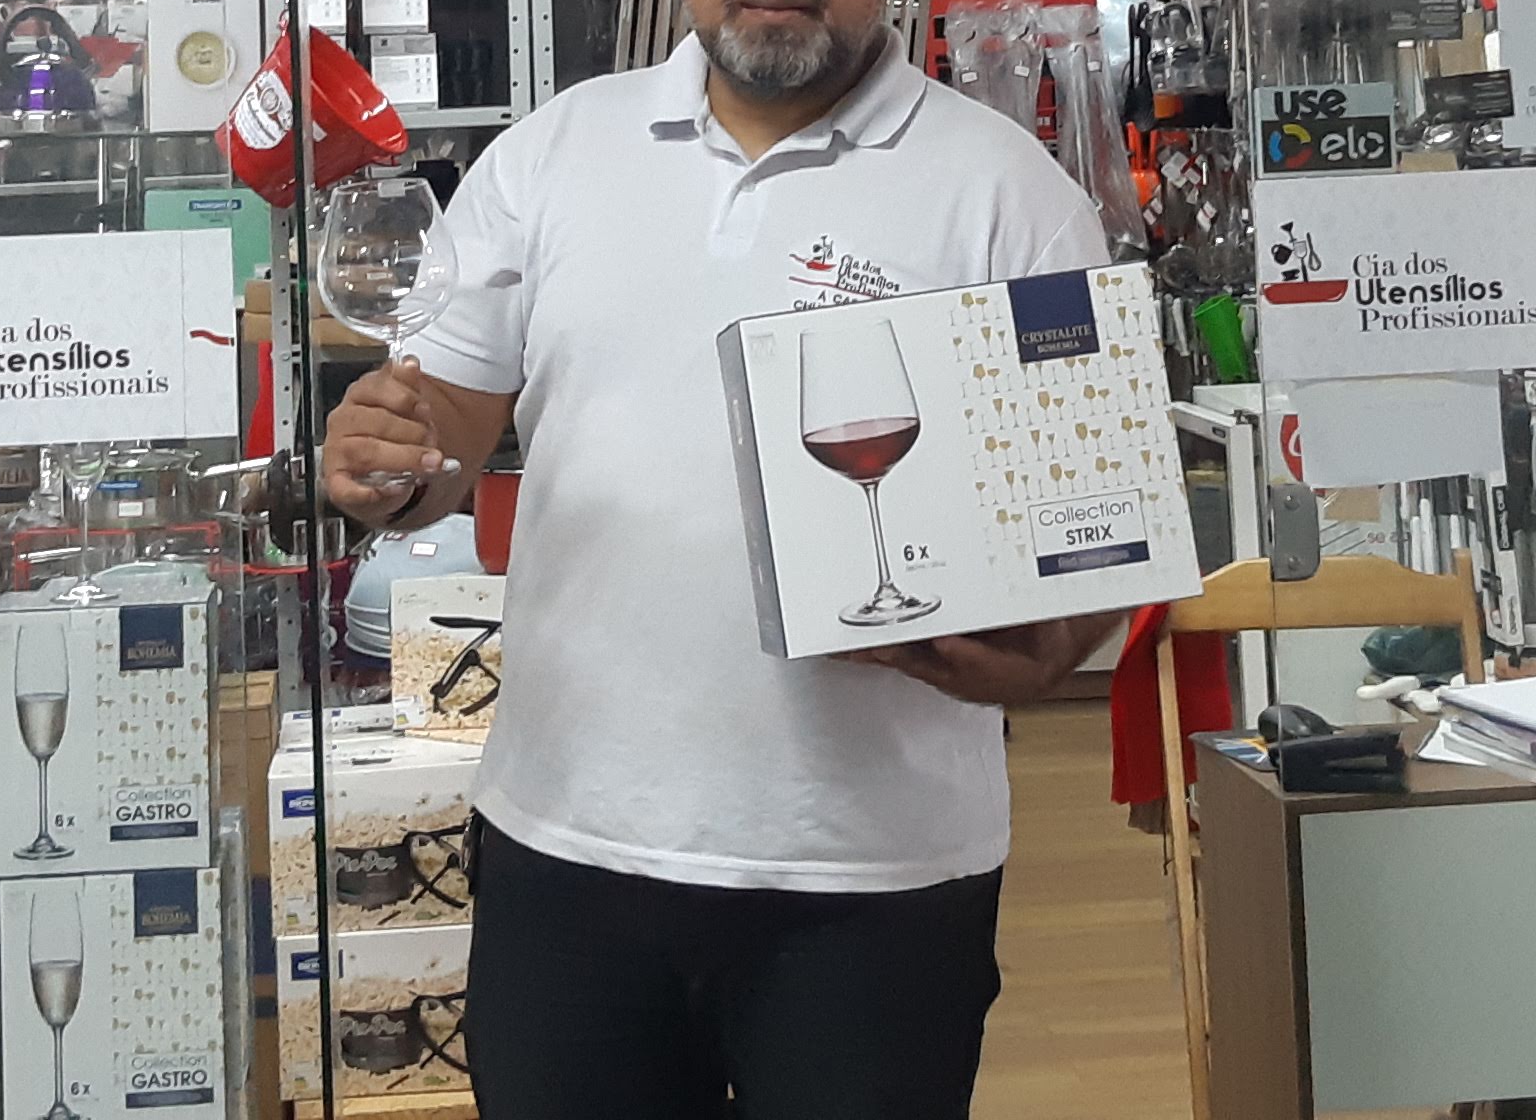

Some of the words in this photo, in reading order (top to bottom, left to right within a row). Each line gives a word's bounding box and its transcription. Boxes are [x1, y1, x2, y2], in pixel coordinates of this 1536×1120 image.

[1274, 87, 1346, 120] use
[1319, 126, 1384, 161] elo
[1352, 255, 1396, 277] Cia
[1404, 251, 1447, 274] dos
[1354, 276, 1503, 305] Utensílios
[26, 317, 73, 342] dos
[1021, 324, 1094, 345] CRYSTALITE
[1038, 498, 1134, 527] Collection
[1065, 524, 1113, 545] STRIX
[903, 545, 915, 561] 6
[918, 545, 929, 559] x
[55, 815, 64, 827] 6
[116, 803, 191, 821] GASTRO
[70, 1082, 80, 1095] 6
[132, 1070, 207, 1088] GASTRO
